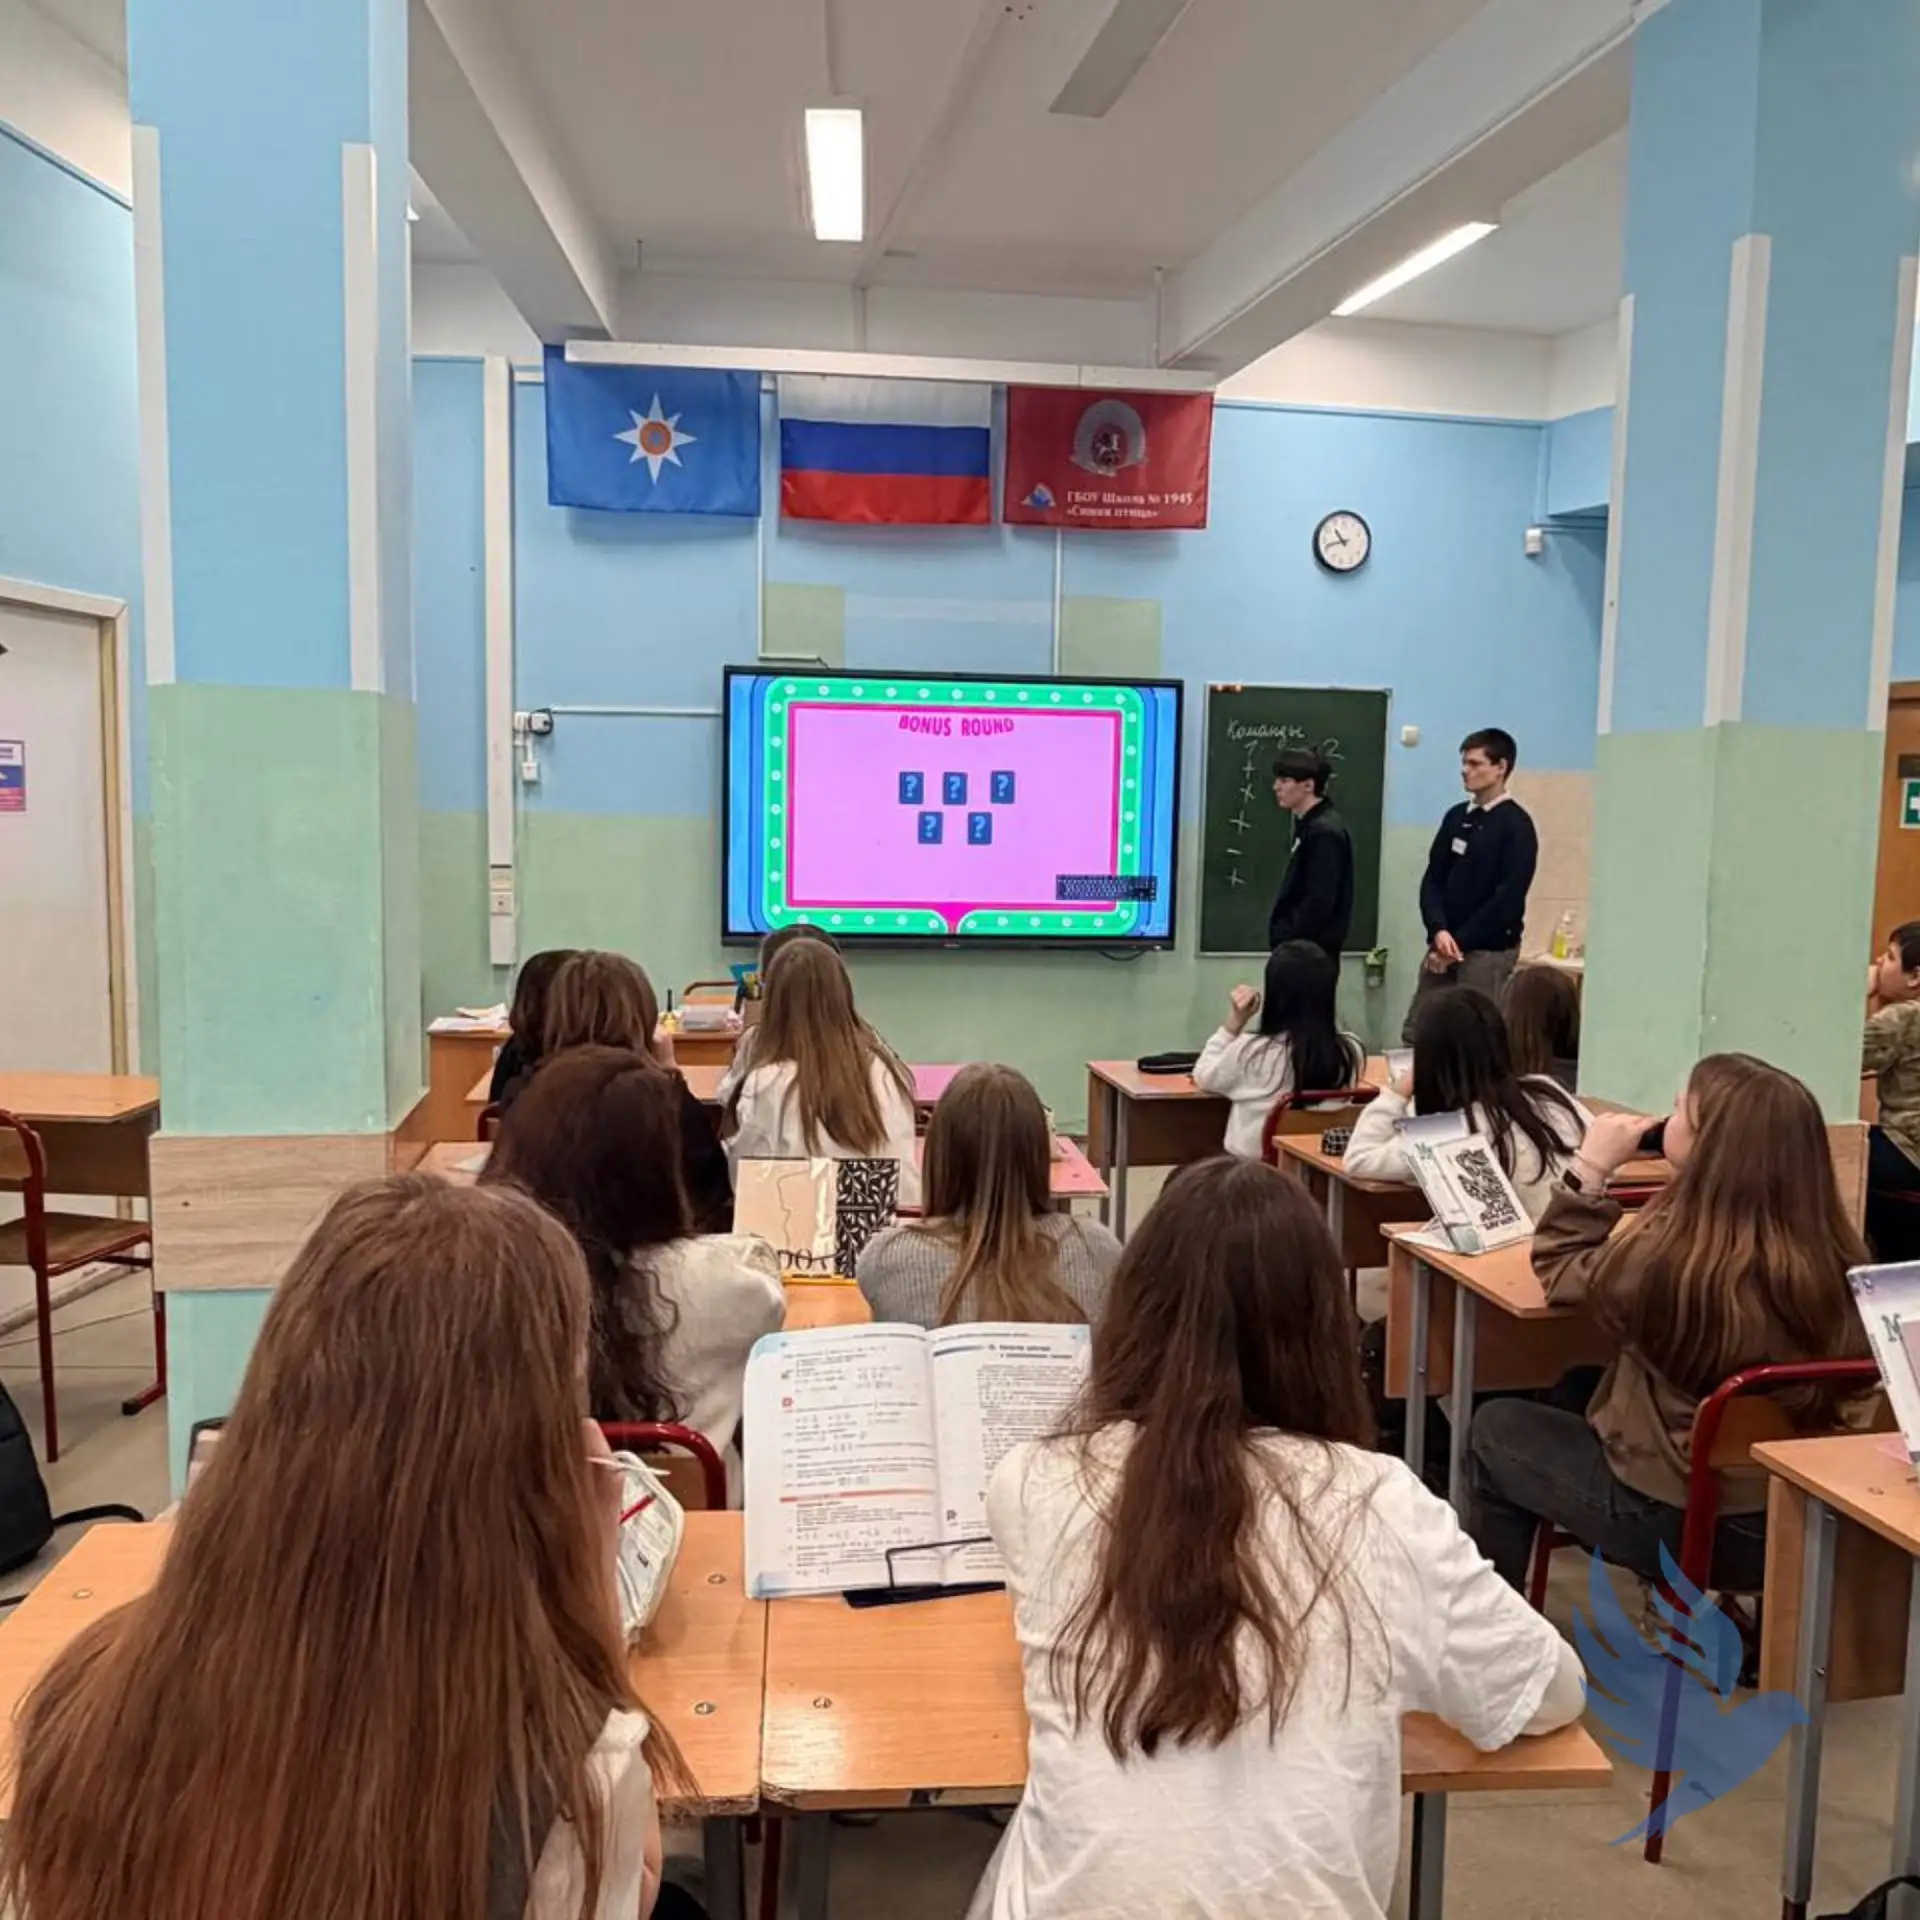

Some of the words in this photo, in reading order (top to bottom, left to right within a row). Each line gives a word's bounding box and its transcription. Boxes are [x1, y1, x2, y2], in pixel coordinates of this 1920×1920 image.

[1067, 491, 1098, 503] ГБОУ
[1164, 493, 1193, 506] 1945
[899, 715, 952, 737] BONUS
[961, 717, 1015, 737] ROUND
